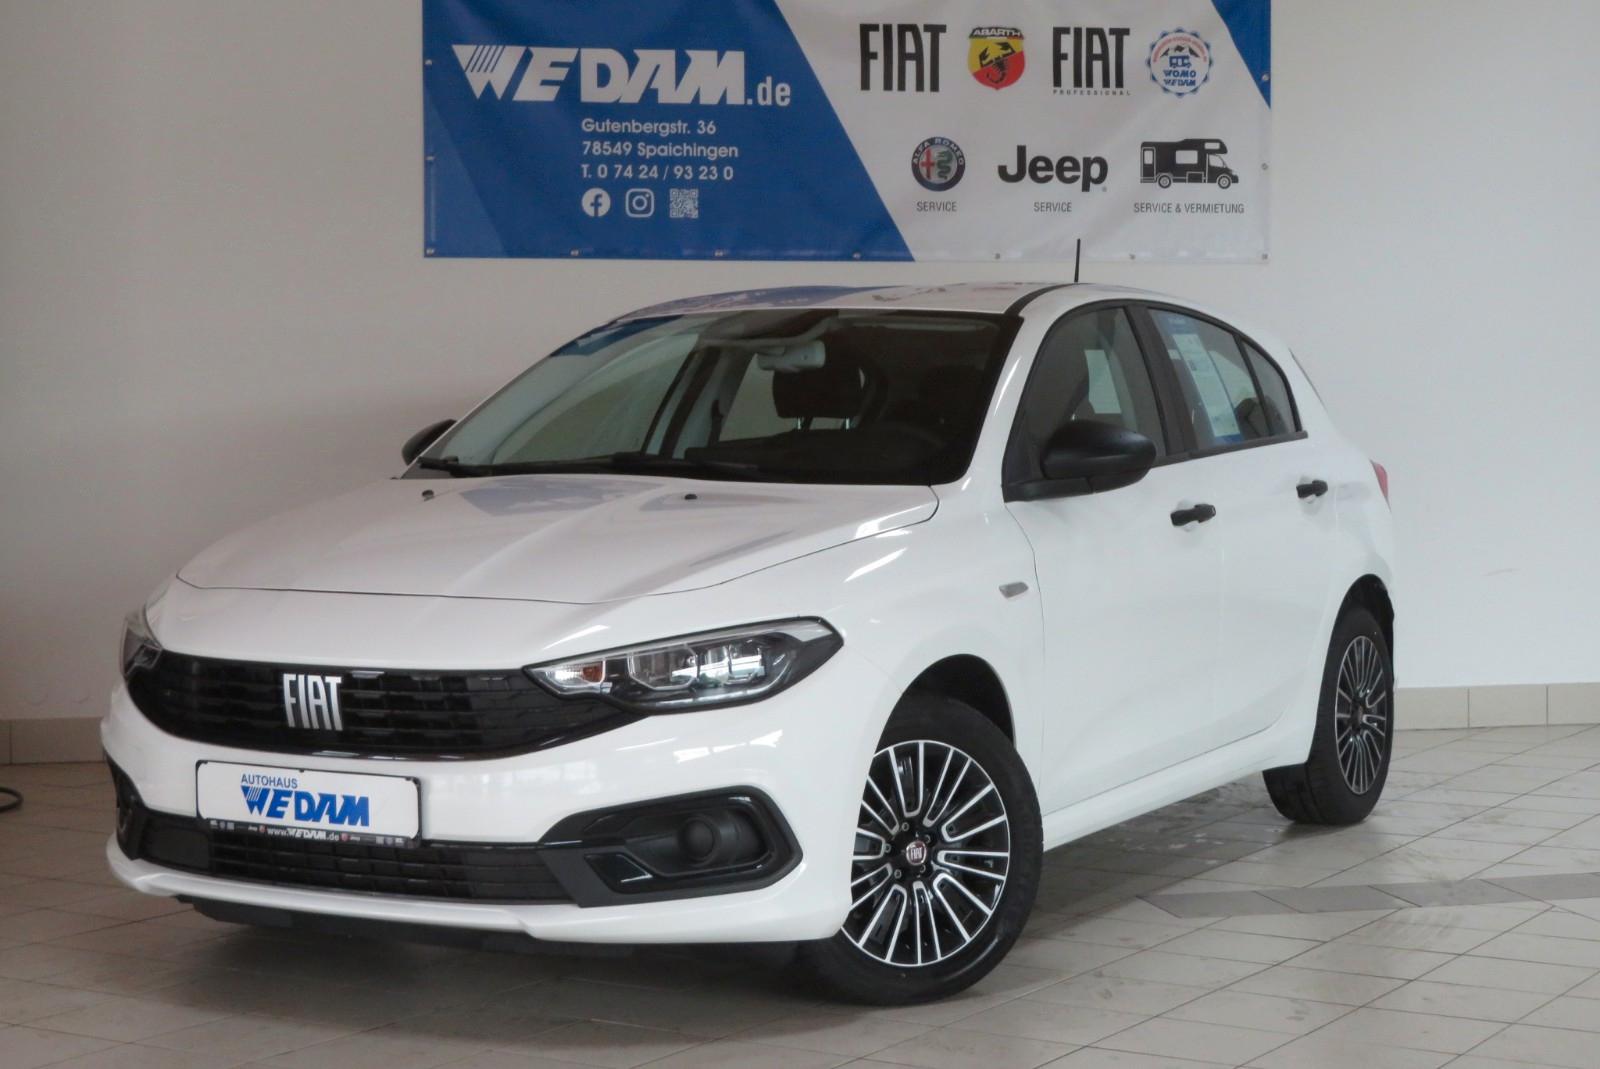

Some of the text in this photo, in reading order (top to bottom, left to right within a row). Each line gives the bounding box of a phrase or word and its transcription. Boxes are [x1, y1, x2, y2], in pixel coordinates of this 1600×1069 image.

[973, 28, 1021, 38] ABARTH
[859, 23, 947, 92] FIAT
[1053, 27, 1130, 89] FIAT
[581, 118, 717, 137] Gutenbergstr. 36
[582, 141, 739, 161] 78549 Spaichingen
[581, 164, 592, 178] T.
[597, 164, 608, 178] 0
[614, 165, 633, 179] 74
[638, 165, 658, 179] 24
[673, 165, 693, 180] 93
[698, 166, 718, 180] 23
[723, 166, 734, 180] 0
[997, 144, 1108, 192] Jeep
[916, 200, 957, 212] SERVICE
[1033, 201, 1072, 213] SERVICE
[1133, 202, 1245, 214] SERVICE & VERMIETUNG
[283, 673, 343, 731] FIAT
[241, 773, 298, 789] AUTOHAUS
[240, 785, 370, 828] WEDAM
